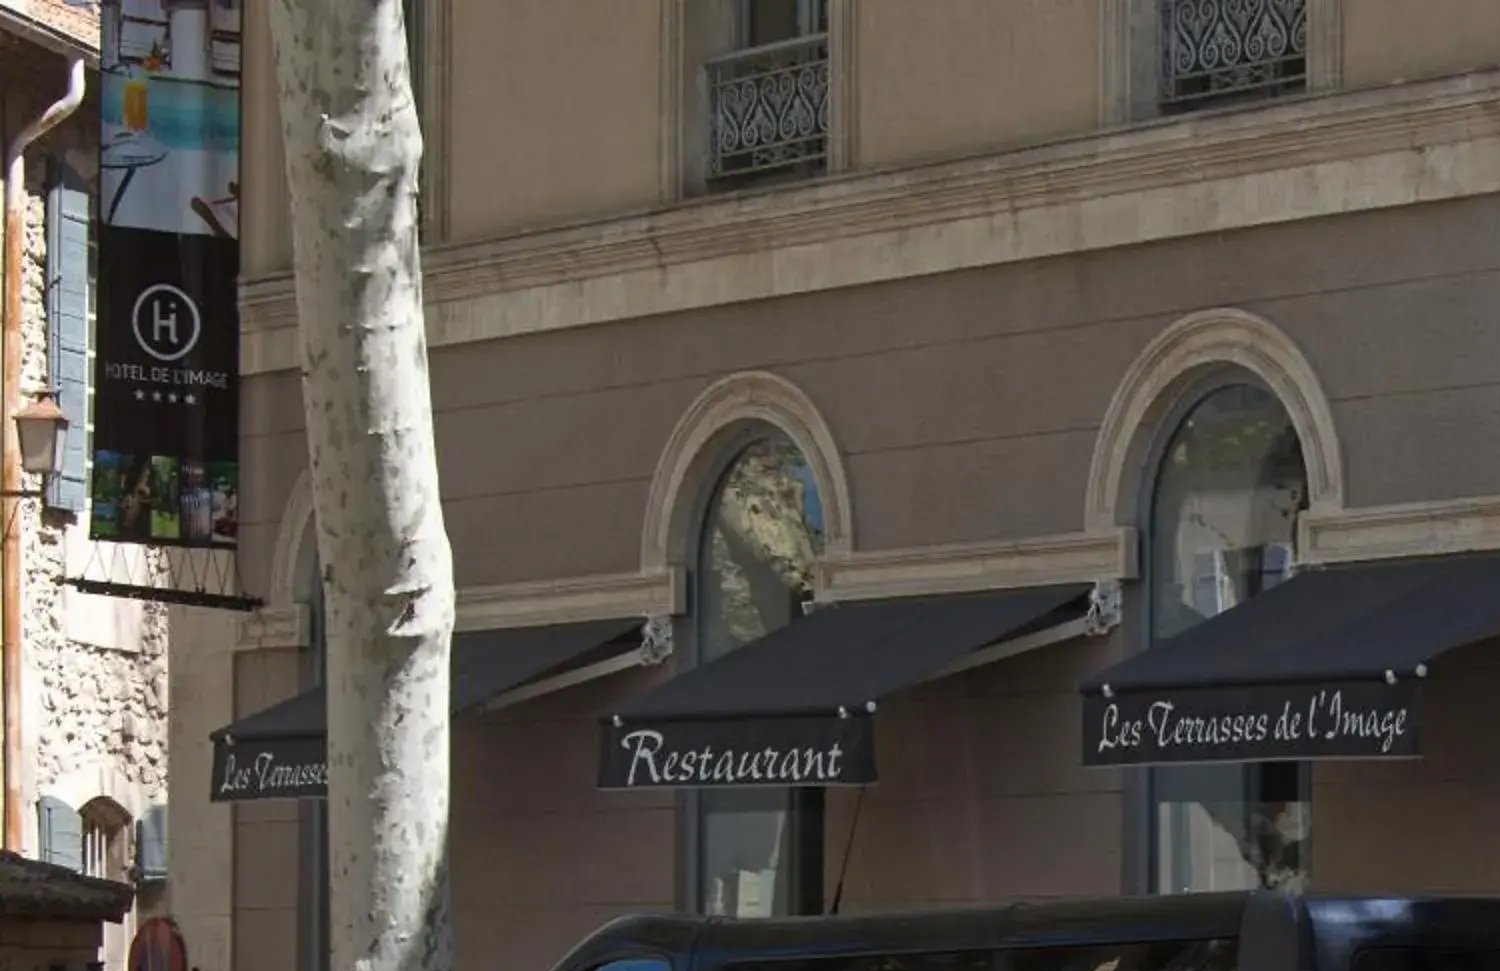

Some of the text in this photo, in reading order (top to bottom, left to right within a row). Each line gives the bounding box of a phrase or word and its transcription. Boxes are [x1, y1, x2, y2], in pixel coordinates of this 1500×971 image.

[104, 361, 147, 381] HOTEL
[151, 367, 170, 383] DE
[1098, 689, 1408, 753] Les Terrasses de l'Image
[220, 753, 252, 793] Les
[621, 729, 843, 786] Restaurant
